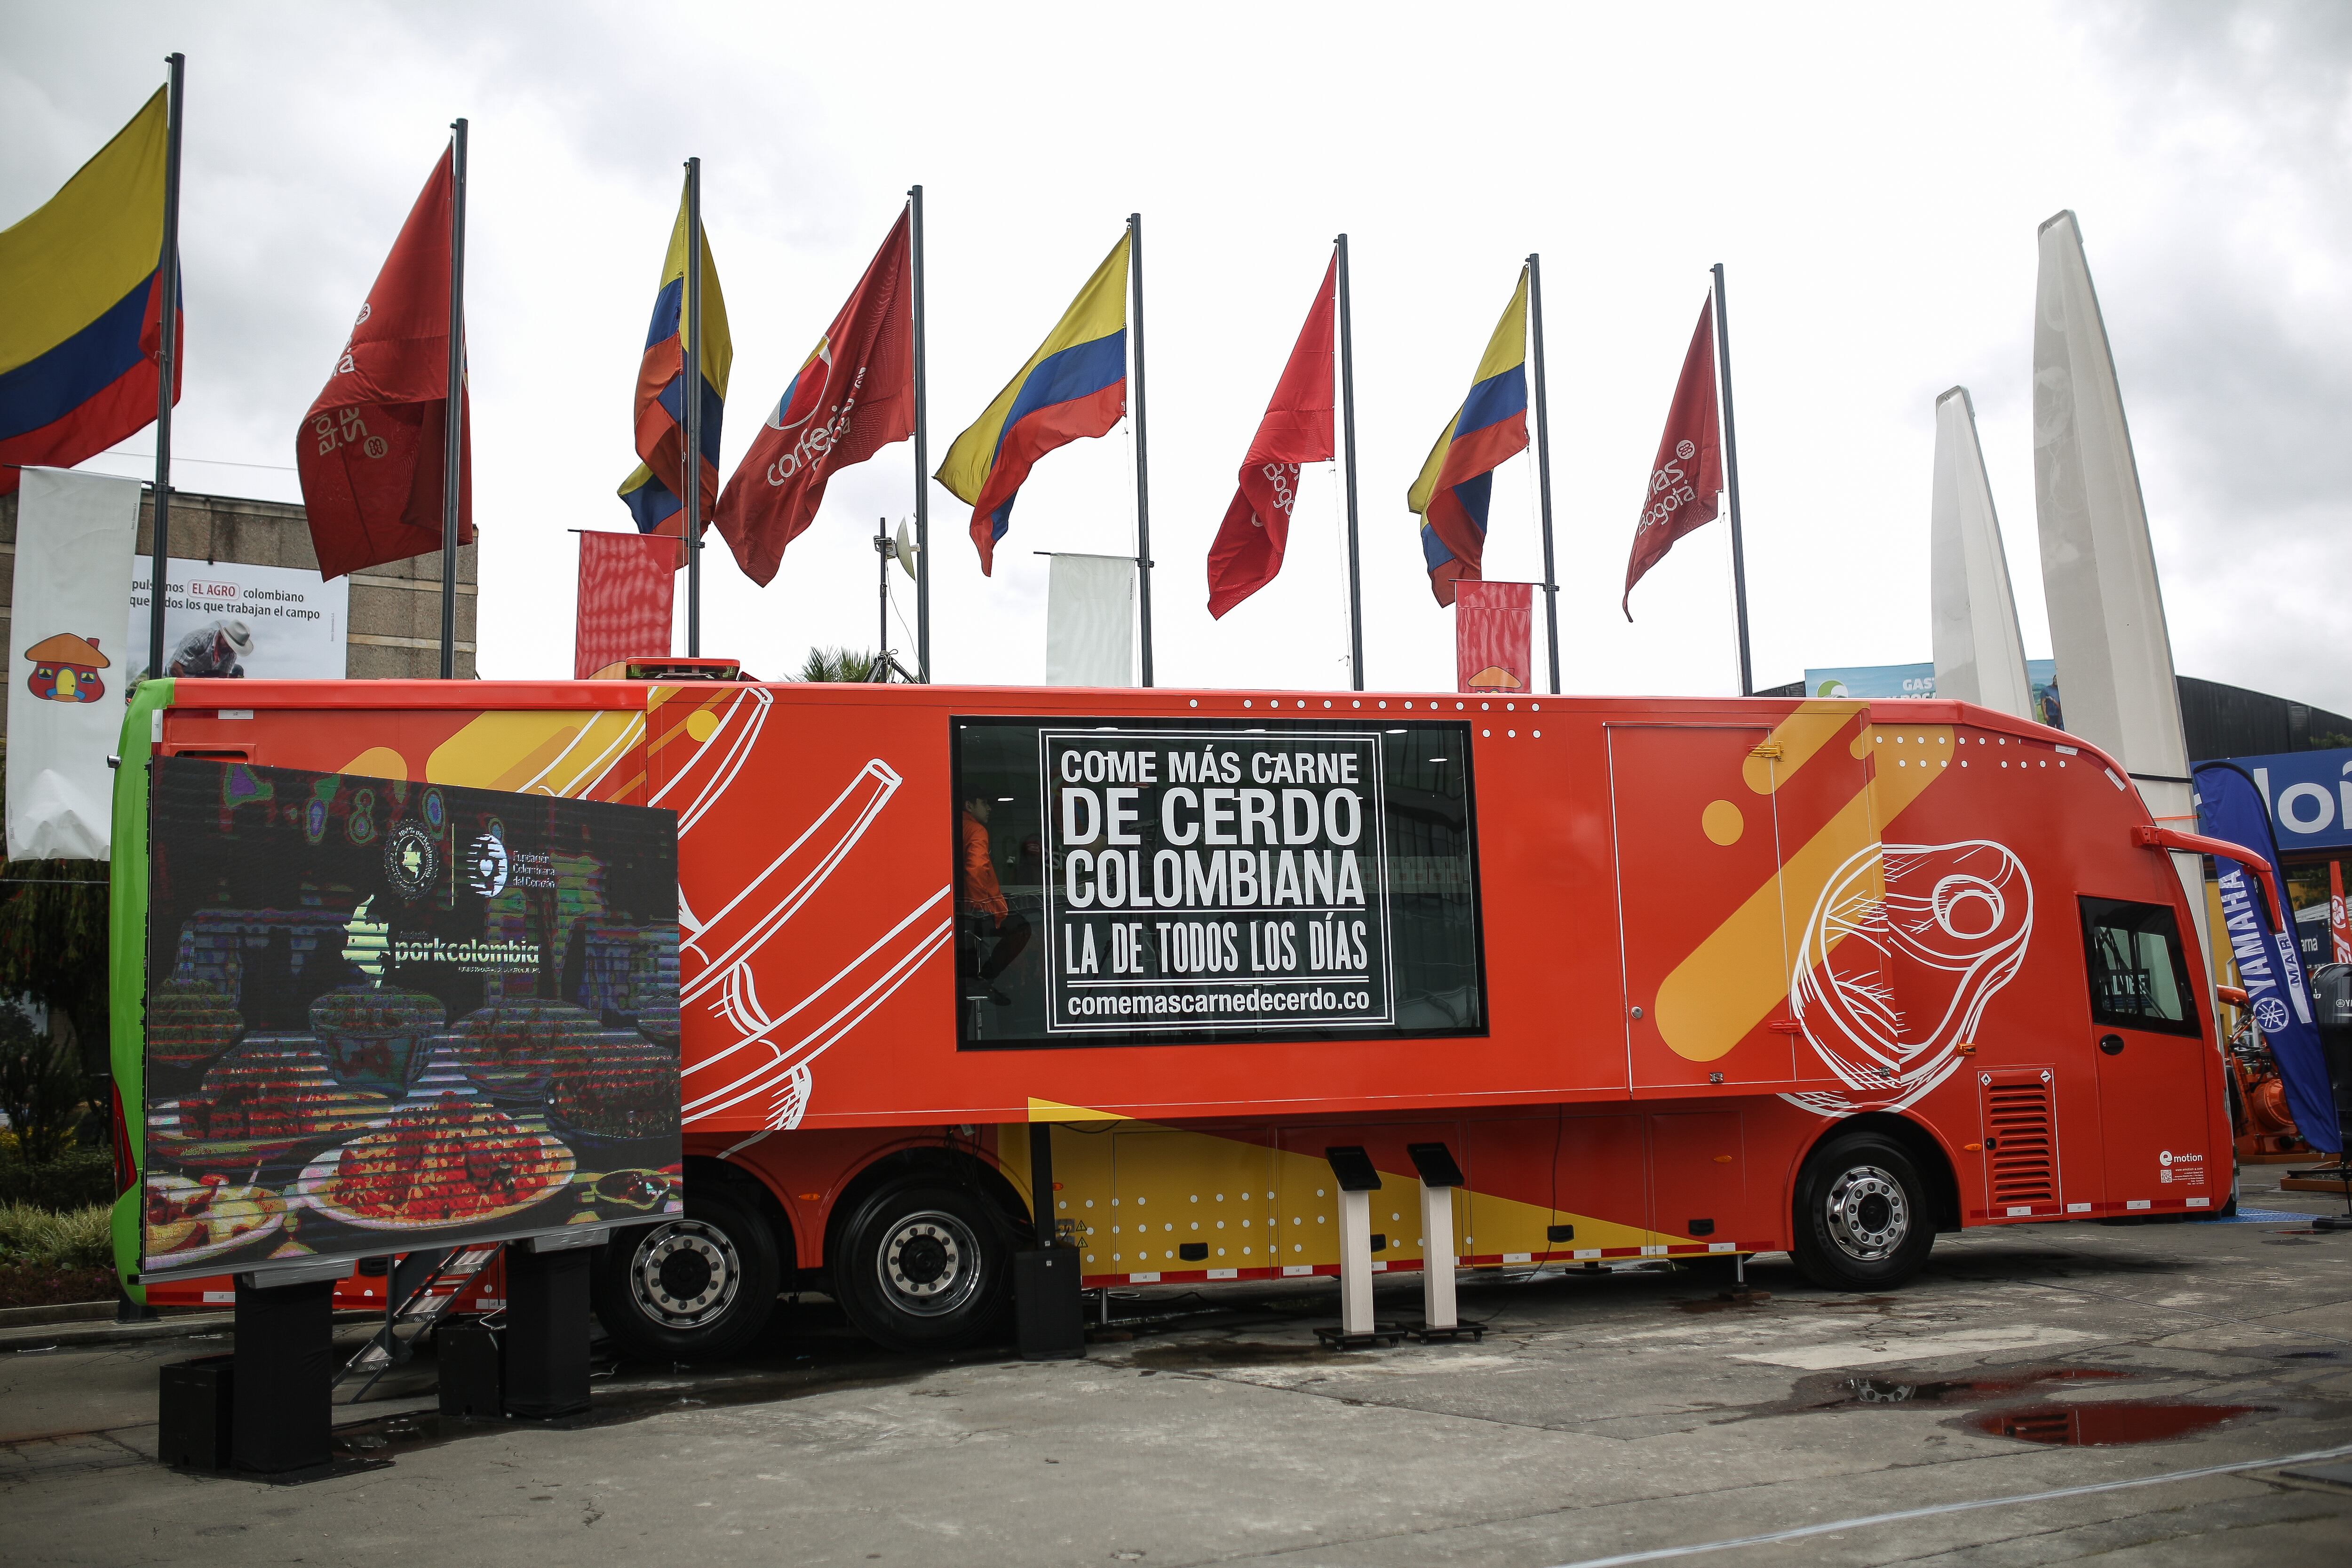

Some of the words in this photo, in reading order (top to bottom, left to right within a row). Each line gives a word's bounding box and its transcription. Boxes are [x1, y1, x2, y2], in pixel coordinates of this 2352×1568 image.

[1639, 479, 1696, 537] Bogotá
[186, 598, 200, 609] los
[204, 602, 223, 613] que
[226, 603, 270, 617] trabajan
[274, 605, 283, 616] el
[286, 608, 320, 621] campo
[192, 583, 203, 594] EL
[207, 584, 235, 597] AGRO
[243, 588, 304, 602] colombiano
[1061, 750, 1157, 783] COME
[1168, 744, 1241, 783] MÁS
[1251, 752, 1359, 784] CARNE
[1061, 787, 1141, 845] DE
[1161, 787, 1362, 846] CERDO
[1065, 849, 1366, 908] COLOMBIANA
[395, 938, 540, 969] porkcolombia
[1065, 923, 1099, 974] LA
[1112, 923, 1144, 974] DE
[1156, 921, 1239, 973] TODOS
[1249, 921, 1297, 972] LOS
[1309, 912, 1367, 971] DÍAS
[2218, 869, 2277, 999] YAMAHA
[1068, 987, 1370, 1015] comemascarnedecerdo.co
